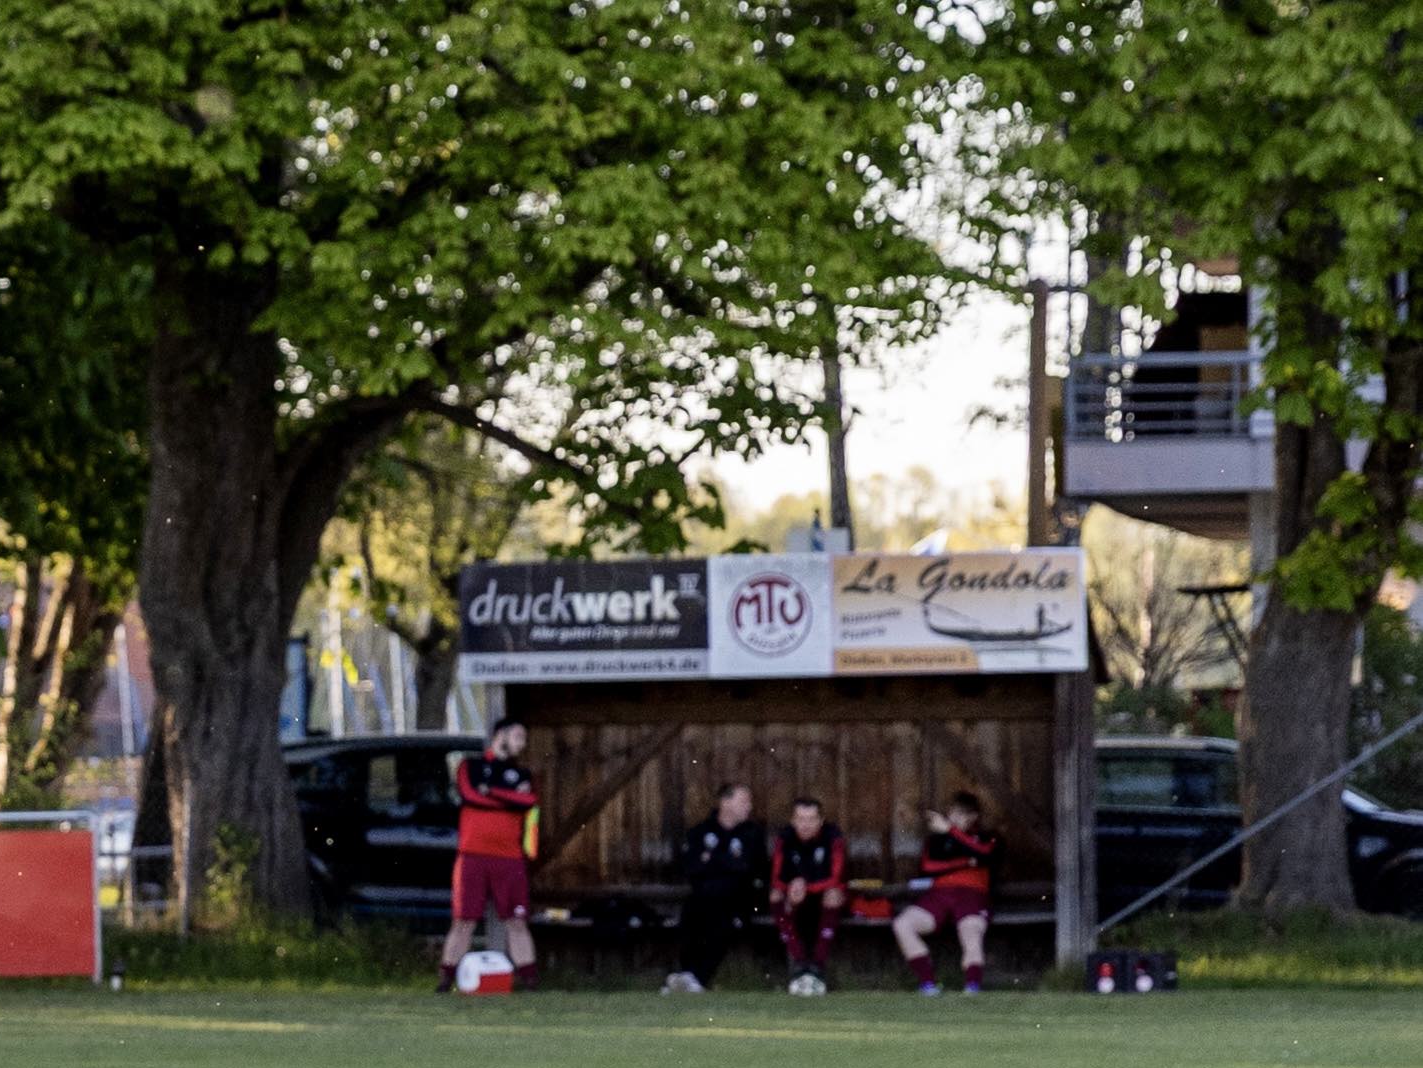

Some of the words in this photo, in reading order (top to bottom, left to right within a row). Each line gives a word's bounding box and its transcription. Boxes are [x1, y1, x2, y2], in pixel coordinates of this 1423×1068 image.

[468, 574, 681, 626] druckwerk
[842, 558, 897, 593] La
[917, 558, 1069, 603] Gondola
